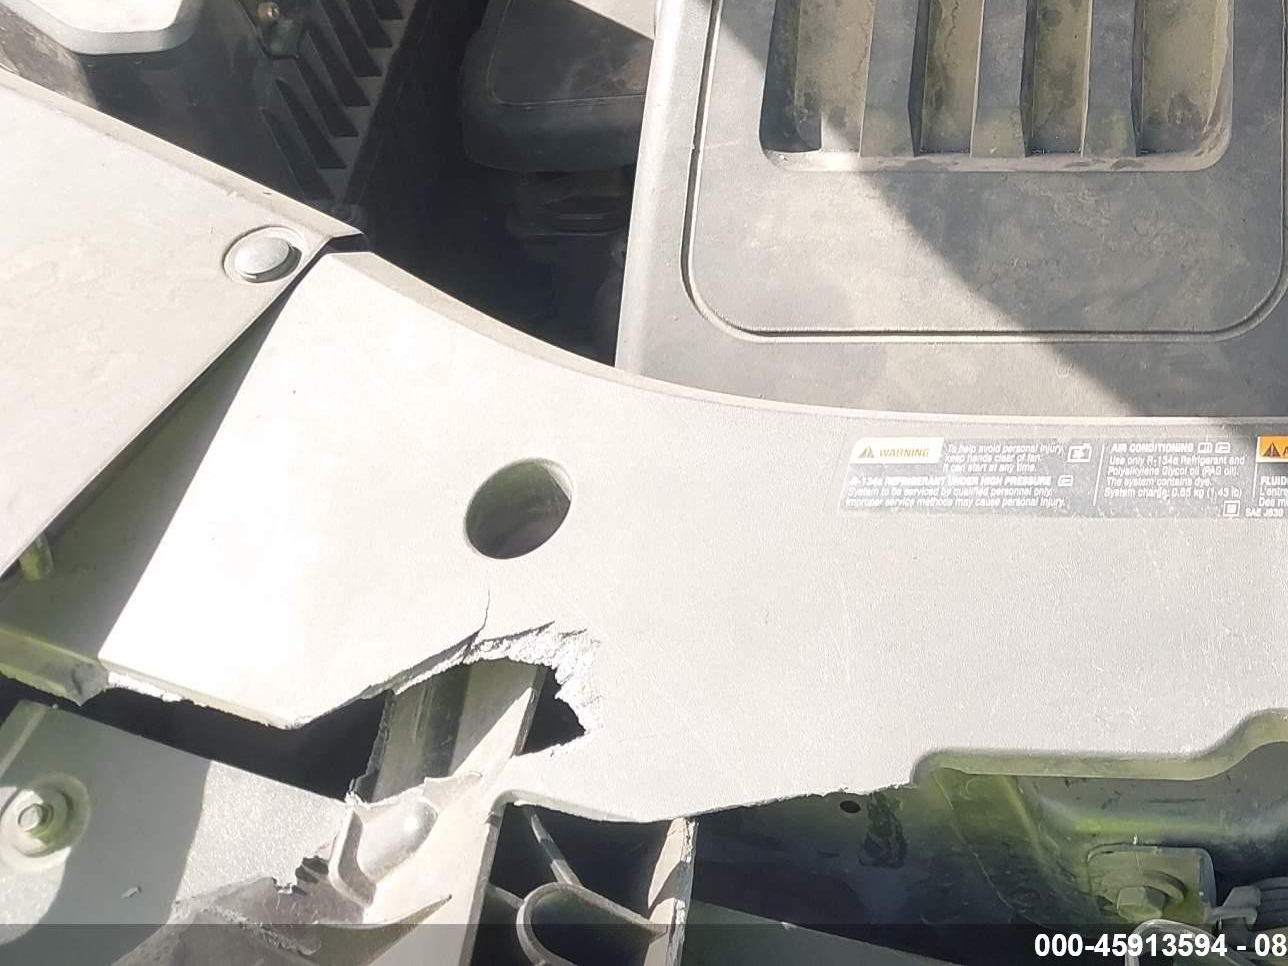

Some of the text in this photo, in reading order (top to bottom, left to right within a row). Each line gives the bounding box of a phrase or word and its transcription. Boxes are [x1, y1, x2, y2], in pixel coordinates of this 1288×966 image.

[879, 447, 929, 458] WARNING
[1111, 442, 1194, 453] AIR CONDITIONING
[1109, 456, 1126, 465] Use
[1127, 456, 1145, 466] only
[1180, 455, 1228, 466] Refrigerant
[1228, 456, 1246, 465] and
[1107, 466, 1160, 476] Polyalkylene
[1161, 466, 1188, 476] Glycol
[1189, 466, 1200, 475] oil
[1201, 466, 1222, 476] (PAG
[1106, 476, 1212, 487] The system contains dye.
[1258, 497, 1275, 507] Des
[1245, 507, 1261, 517] SAE
